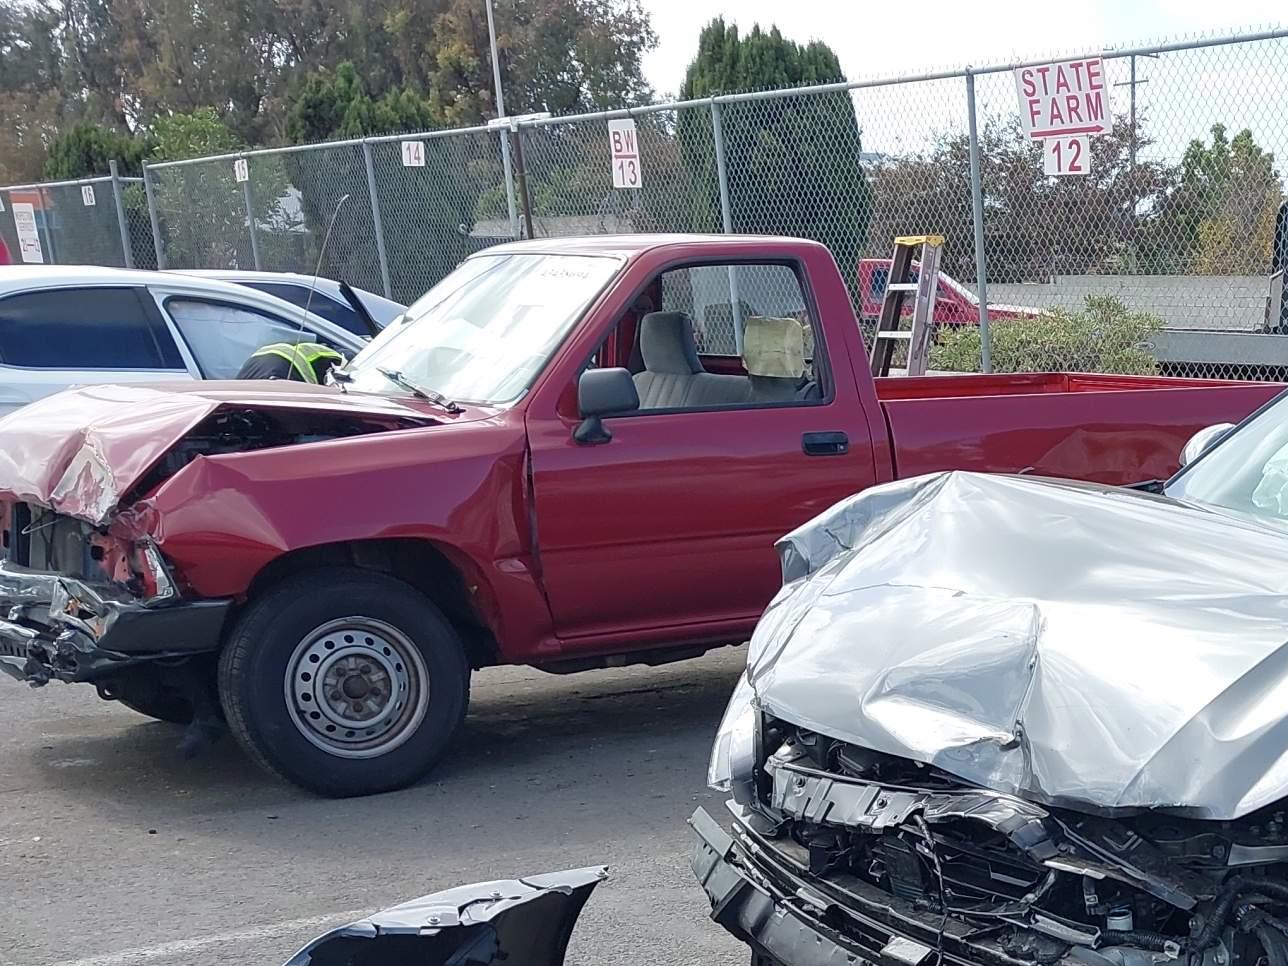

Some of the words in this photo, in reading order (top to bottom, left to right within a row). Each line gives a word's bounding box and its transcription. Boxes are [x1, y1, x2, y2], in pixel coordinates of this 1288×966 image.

[1022, 60, 1103, 97] STATE
[1028, 92, 1104, 127] FARM
[406, 143, 421, 165] 14
[612, 130, 634, 153] BW
[1052, 139, 1082, 172] 12
[237, 160, 247, 180] 15
[618, 160, 637, 186] 13
